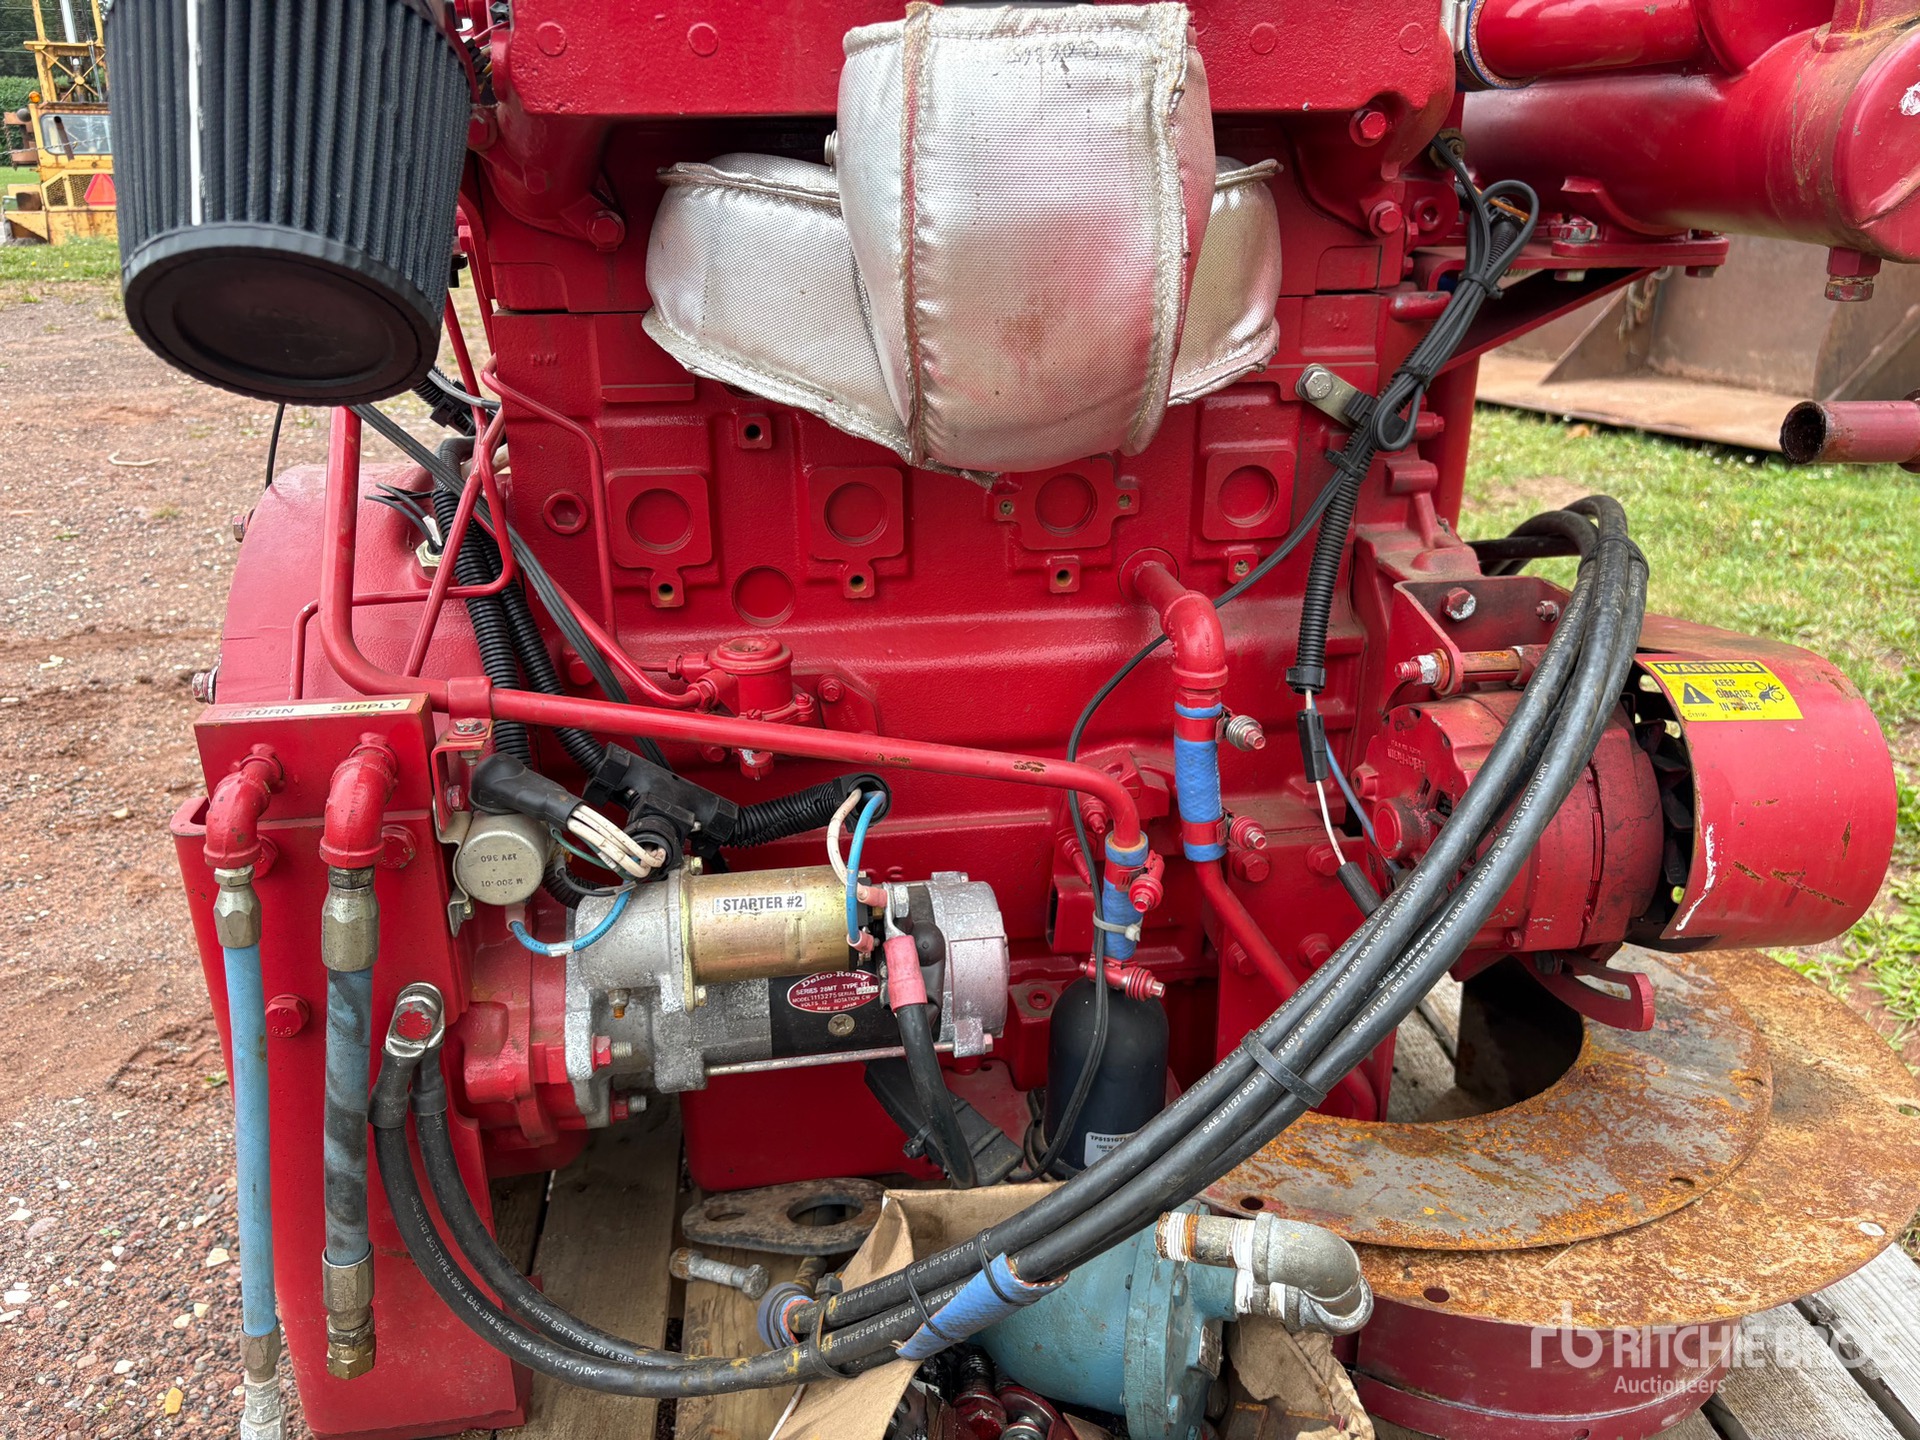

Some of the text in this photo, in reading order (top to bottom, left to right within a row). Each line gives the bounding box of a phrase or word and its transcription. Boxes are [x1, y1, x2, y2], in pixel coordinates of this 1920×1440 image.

[1657, 662, 1762, 673] WARNING
[1712, 678, 1736, 687] KEEP
[1715, 688, 1753, 699] GUARDS
[330, 701, 402, 712] SUPPLY
[1719, 702, 1731, 711] IN
[480, 854, 499, 863] 360
[516, 877, 524, 885] M
[723, 896, 803, 911] STARTER #2
[1352, 1013, 1370, 1033] SAE
[1369, 992, 1391, 1016] J1127
[1390, 973, 1408, 993] SGT
[1405, 951, 1428, 975] TYPE
[1425, 944, 1434, 952] 2
[1445, 920, 1453, 928] &
[1450, 901, 1467, 920] SAE
[1464, 881, 1481, 901] J378
[1477, 864, 1492, 882] 50V
[1488, 848, 1502, 863] 2/0
[1499, 836, 1511, 850] GA
[1535, 762, 1549, 780] DRY
[1278, 1048, 1286, 1056] 2
[1283, 1033, 1299, 1050] 60V
[1298, 1025, 1307, 1033] &
[1304, 1008, 1322, 1026] SAE
[1320, 988, 1338, 1009] J378
[1335, 971, 1351, 989] 50V
[1348, 957, 1362, 973] 2/0
[1360, 944, 1373, 958] GA
[1409, 870, 1425, 891] DRY
[1376, 970, 1396, 989] SAE
[1394, 948, 1416, 973] J1127
[801, 971, 870, 988] Delco-Remy
[796, 987, 818, 995] SERIES
[842, 982, 858, 990] TYPE
[834, 996, 860, 1004] ROTATION
[1202, 1077, 1259, 1134] SAE J1127 SGT
[917, 1264, 927, 1273] GA
[864, 1284, 877, 1296] SAE
[942, 1289, 954, 1300] GA
[435, 1252, 450, 1273] TYPE
[446, 1271, 454, 1279] 2
[466, 1295, 481, 1312] SAE
[479, 1310, 496, 1326] J378
[520, 1340, 532, 1351] GA
[518, 1295, 533, 1309] SAE
[531, 1307, 552, 1324] J1127
[550, 1320, 568, 1334] SGT
[568, 1330, 588, 1346] TYPE
[587, 1341, 594, 1350] 2
[593, 1344, 610, 1357] 60V
[609, 1352, 615, 1360] &
[842, 1330, 861, 1345] TYPE
[861, 1327, 866, 1336] 2
[865, 1322, 879, 1334] 60V
[879, 1320, 885, 1329] &
[885, 1312, 899, 1326] SAE
